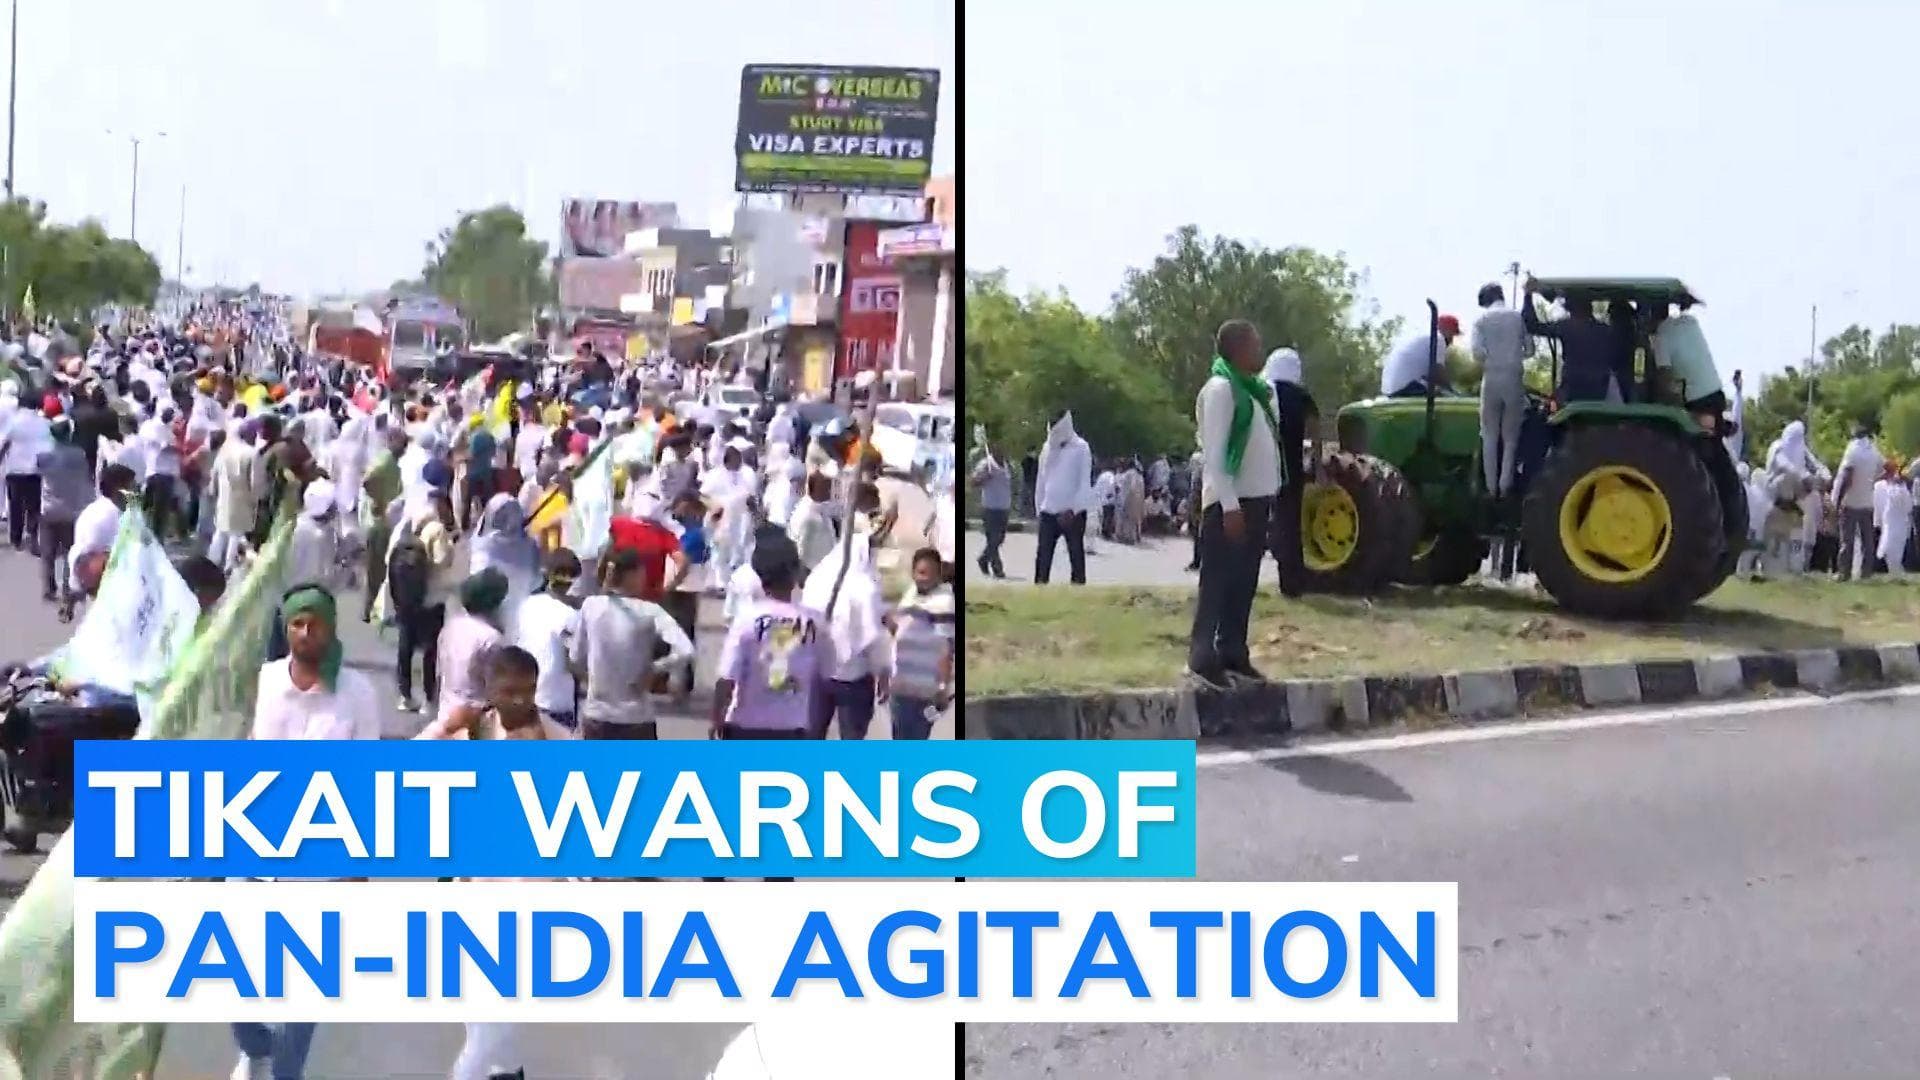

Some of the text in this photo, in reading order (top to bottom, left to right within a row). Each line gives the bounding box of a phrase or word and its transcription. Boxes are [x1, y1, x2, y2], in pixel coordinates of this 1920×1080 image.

[848, 116, 884, 132] VISA
[749, 133, 924, 158] VISA EXPERTS
